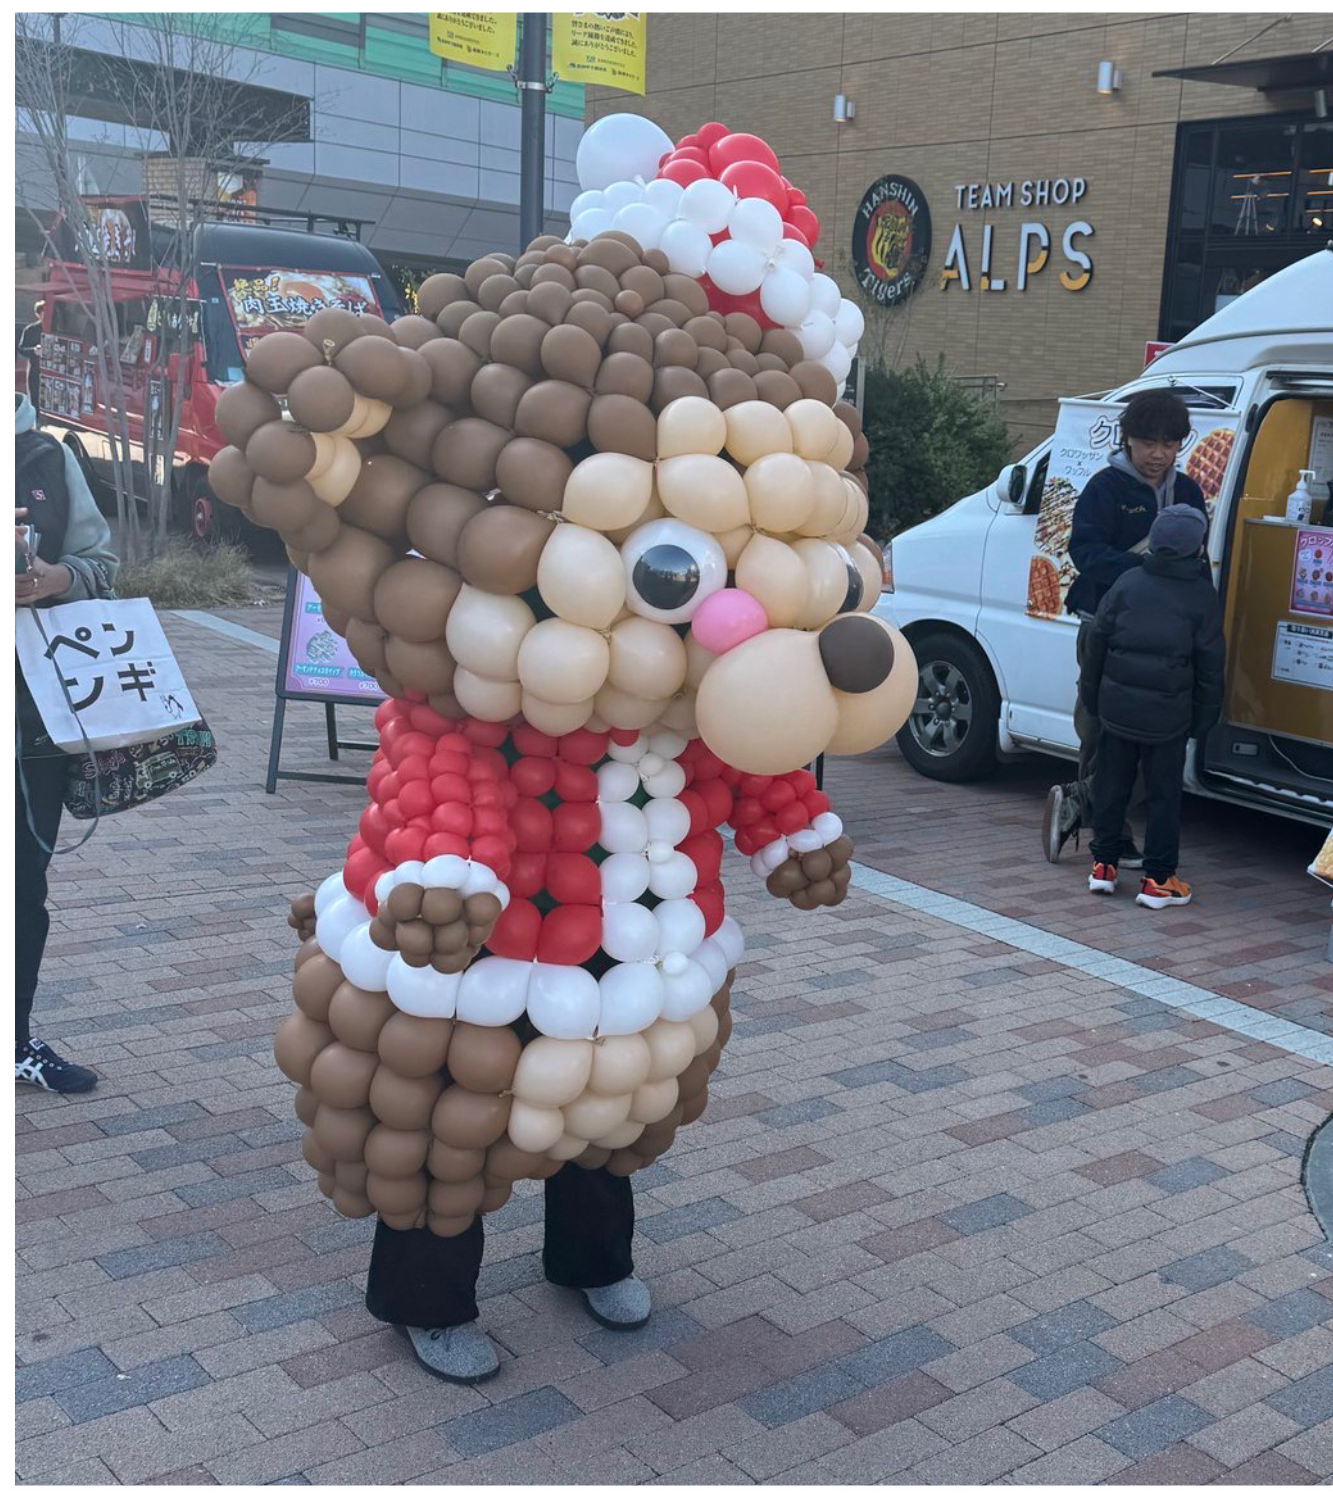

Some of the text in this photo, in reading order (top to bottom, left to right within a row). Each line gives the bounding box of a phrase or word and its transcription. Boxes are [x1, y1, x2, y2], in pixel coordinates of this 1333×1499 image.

[861, 181, 919, 220] HANSHIN
[955, 176, 1088, 210] TEAM SHOP
[938, 220, 1096, 292] ALPS
[861, 266, 914, 300] Tigers
[43, 621, 135, 660] ペン
